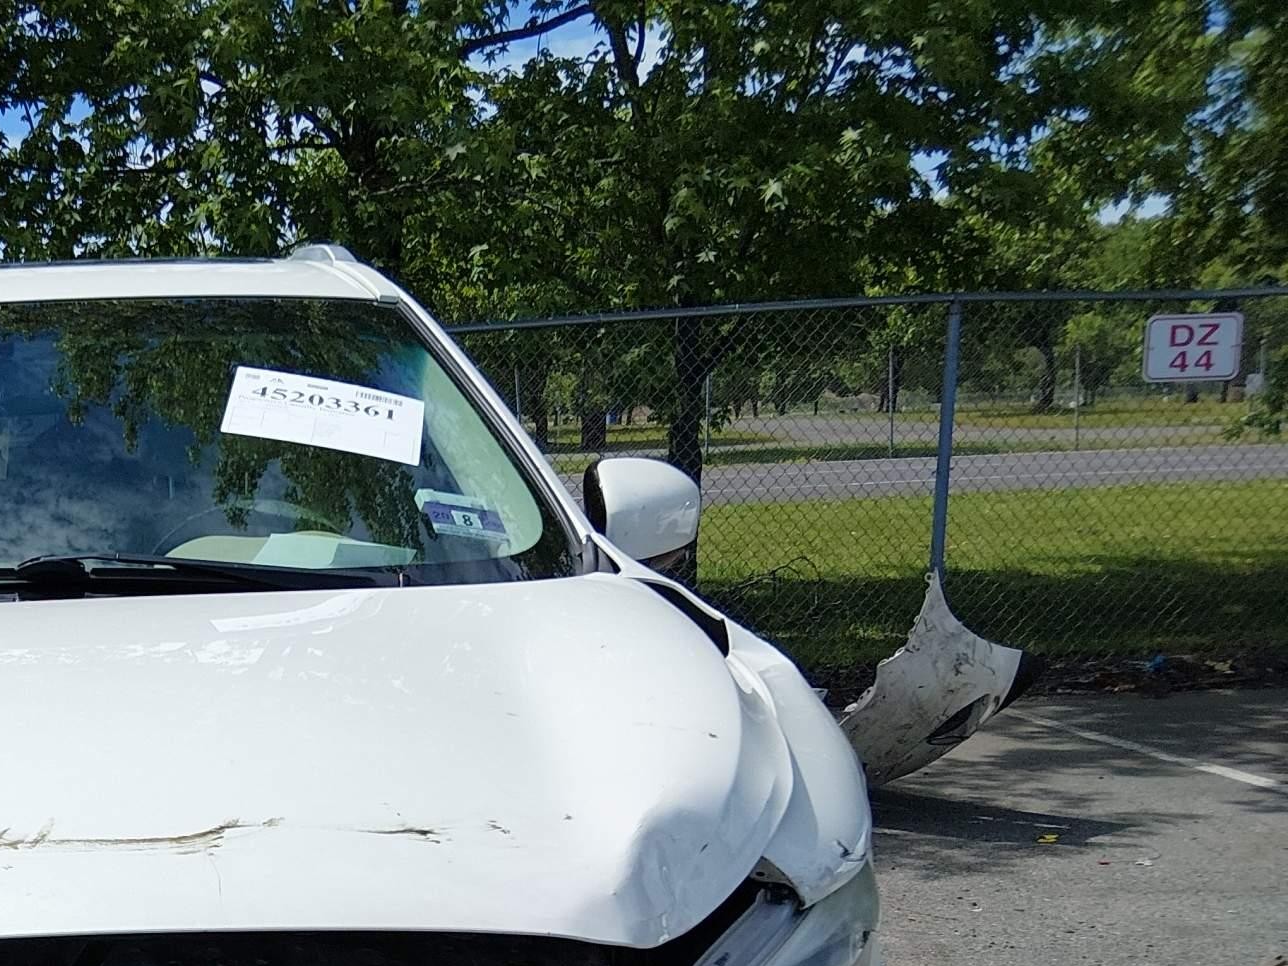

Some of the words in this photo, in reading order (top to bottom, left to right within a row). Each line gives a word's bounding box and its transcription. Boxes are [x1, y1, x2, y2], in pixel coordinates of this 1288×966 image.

[1169, 323, 1220, 347] DZ
[1168, 350, 1215, 372] 44
[252, 386, 395, 420] 45203361
[462, 514, 473, 527] 8
